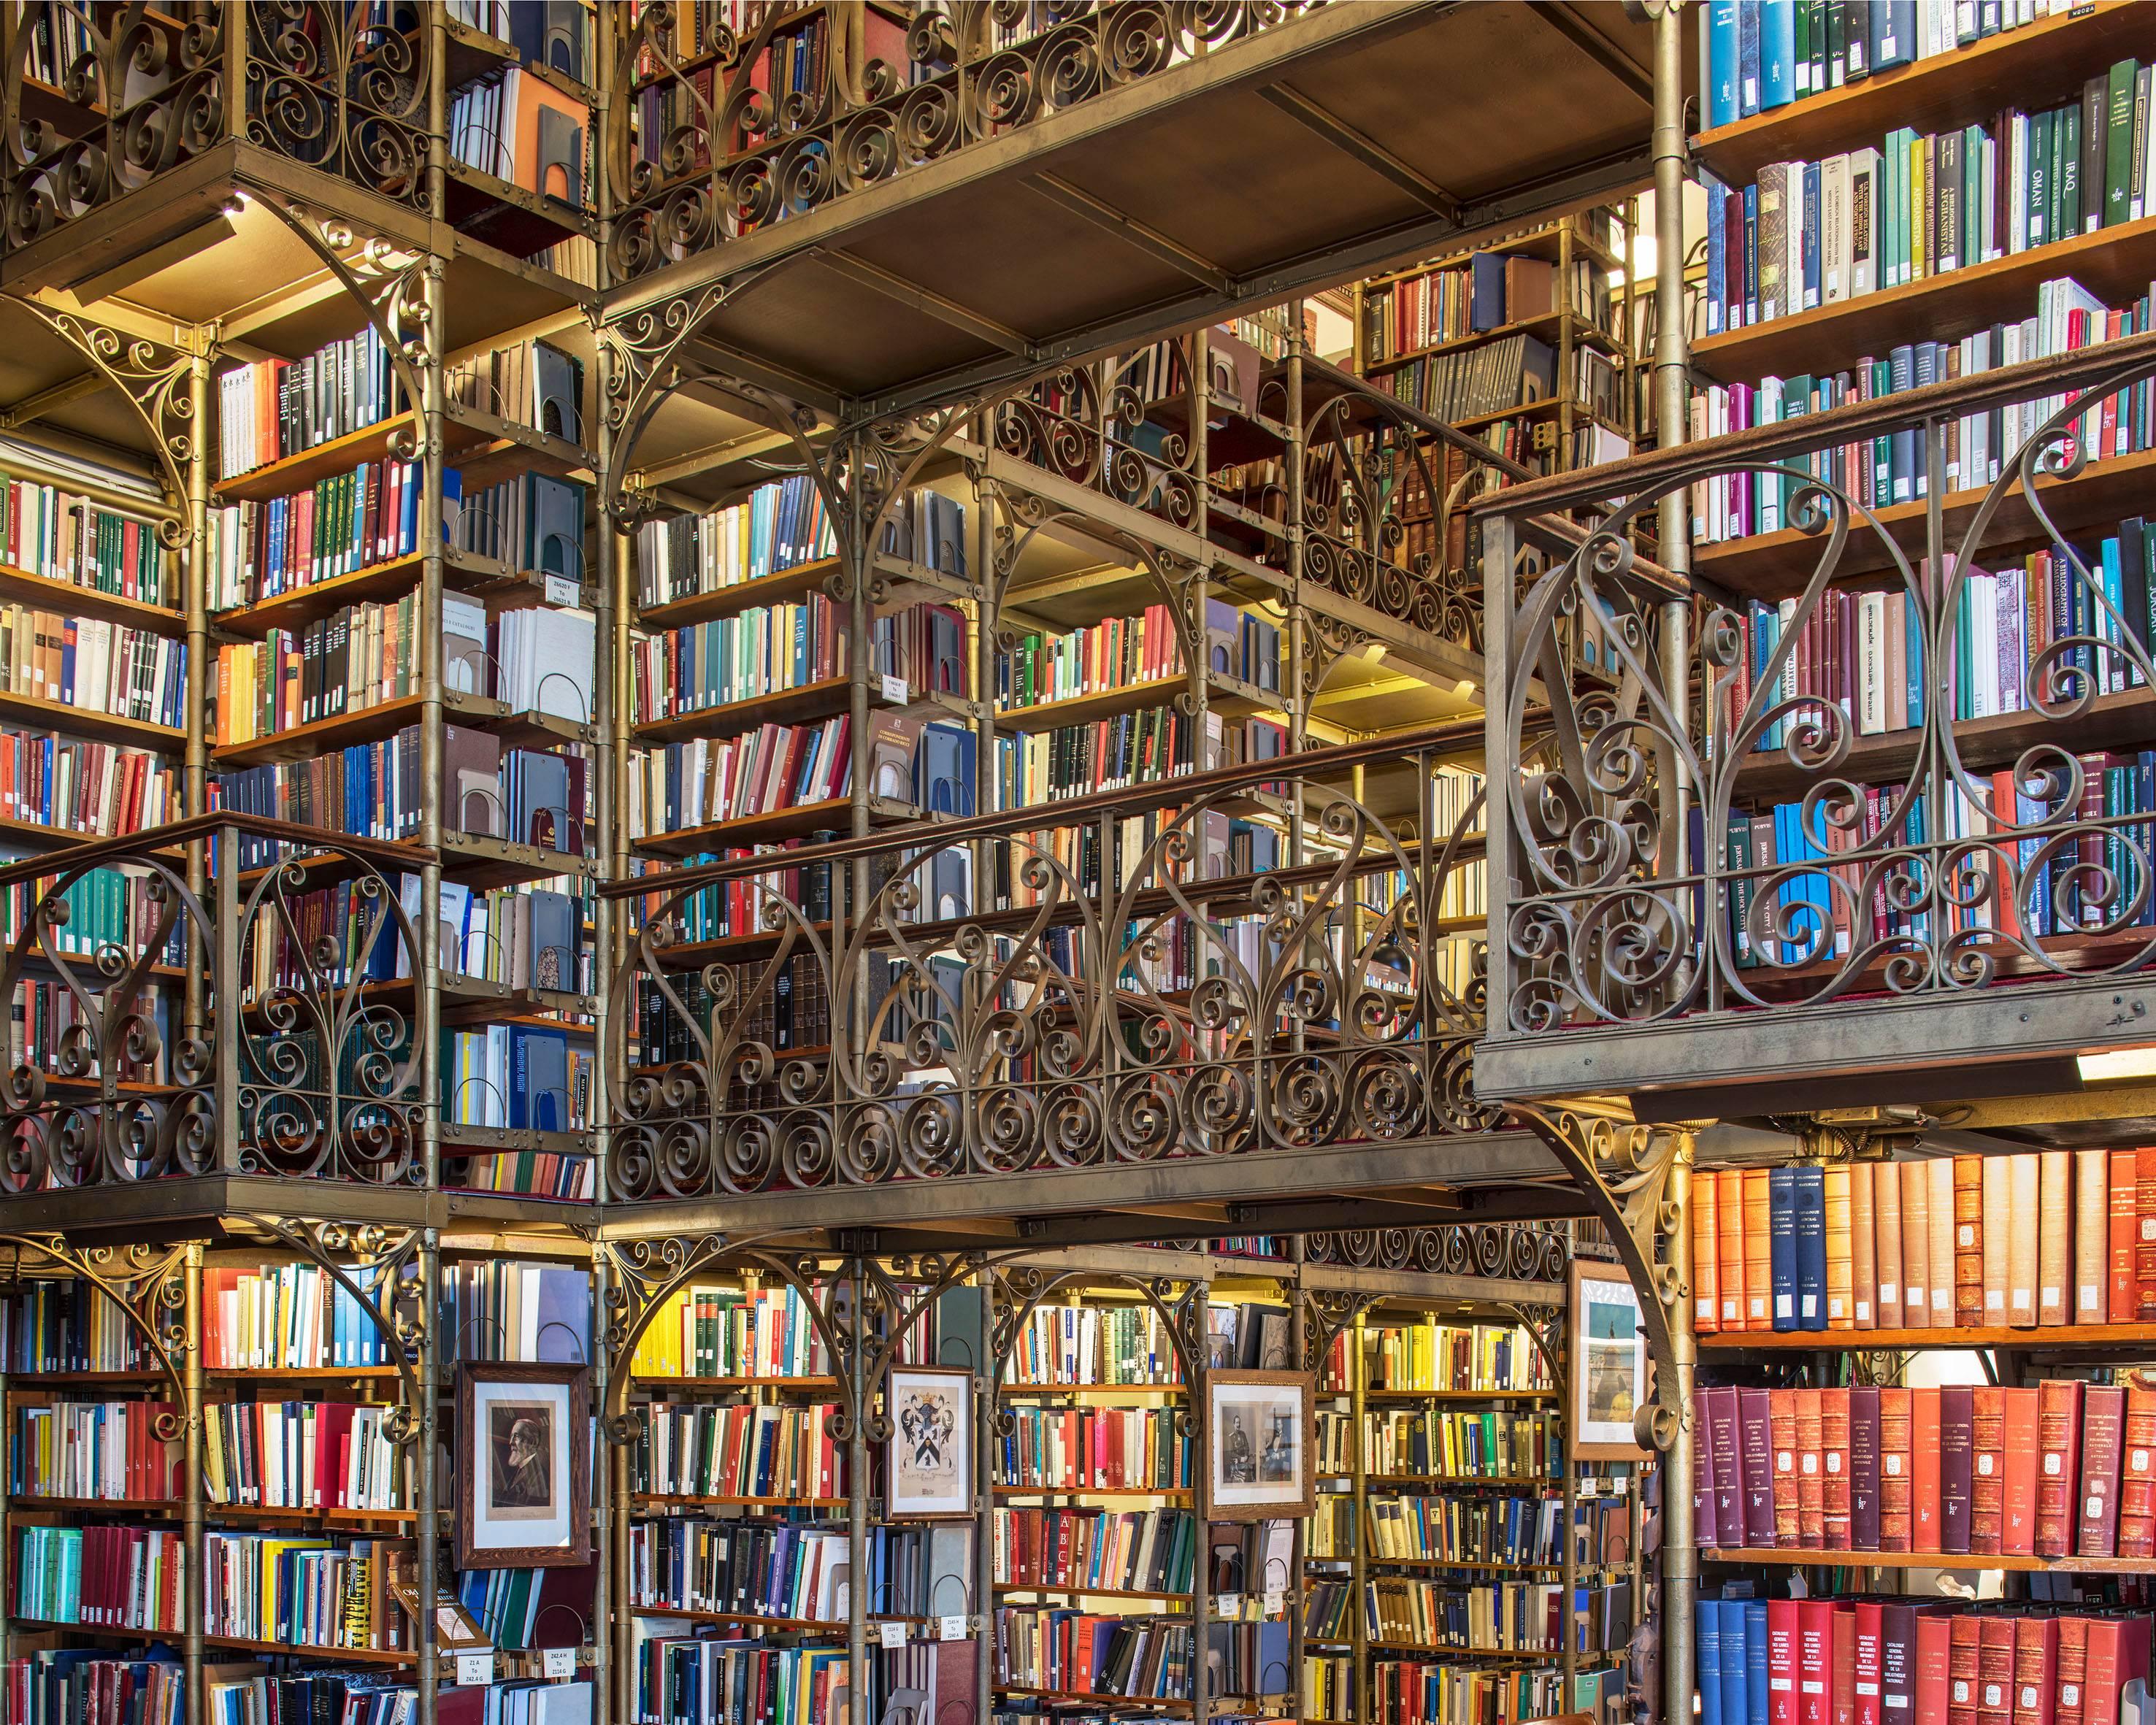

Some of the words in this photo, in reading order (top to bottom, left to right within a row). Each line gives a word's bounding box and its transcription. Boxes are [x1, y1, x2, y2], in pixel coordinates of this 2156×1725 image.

[2072, 6, 2095, 16] W202A
[2063, 161, 2075, 199] IRAQ
[2032, 170, 2043, 207] OMAN
[1949, 245, 1954, 253] OF
[2059, 564, 2067, 615] BIBLIOGRAPHY
[2060, 617, 2067, 627] OF
[1061, 1518, 1069, 1527] A
[1061, 1534, 1066, 1545] B
[1059, 1551, 1066, 1562] C
